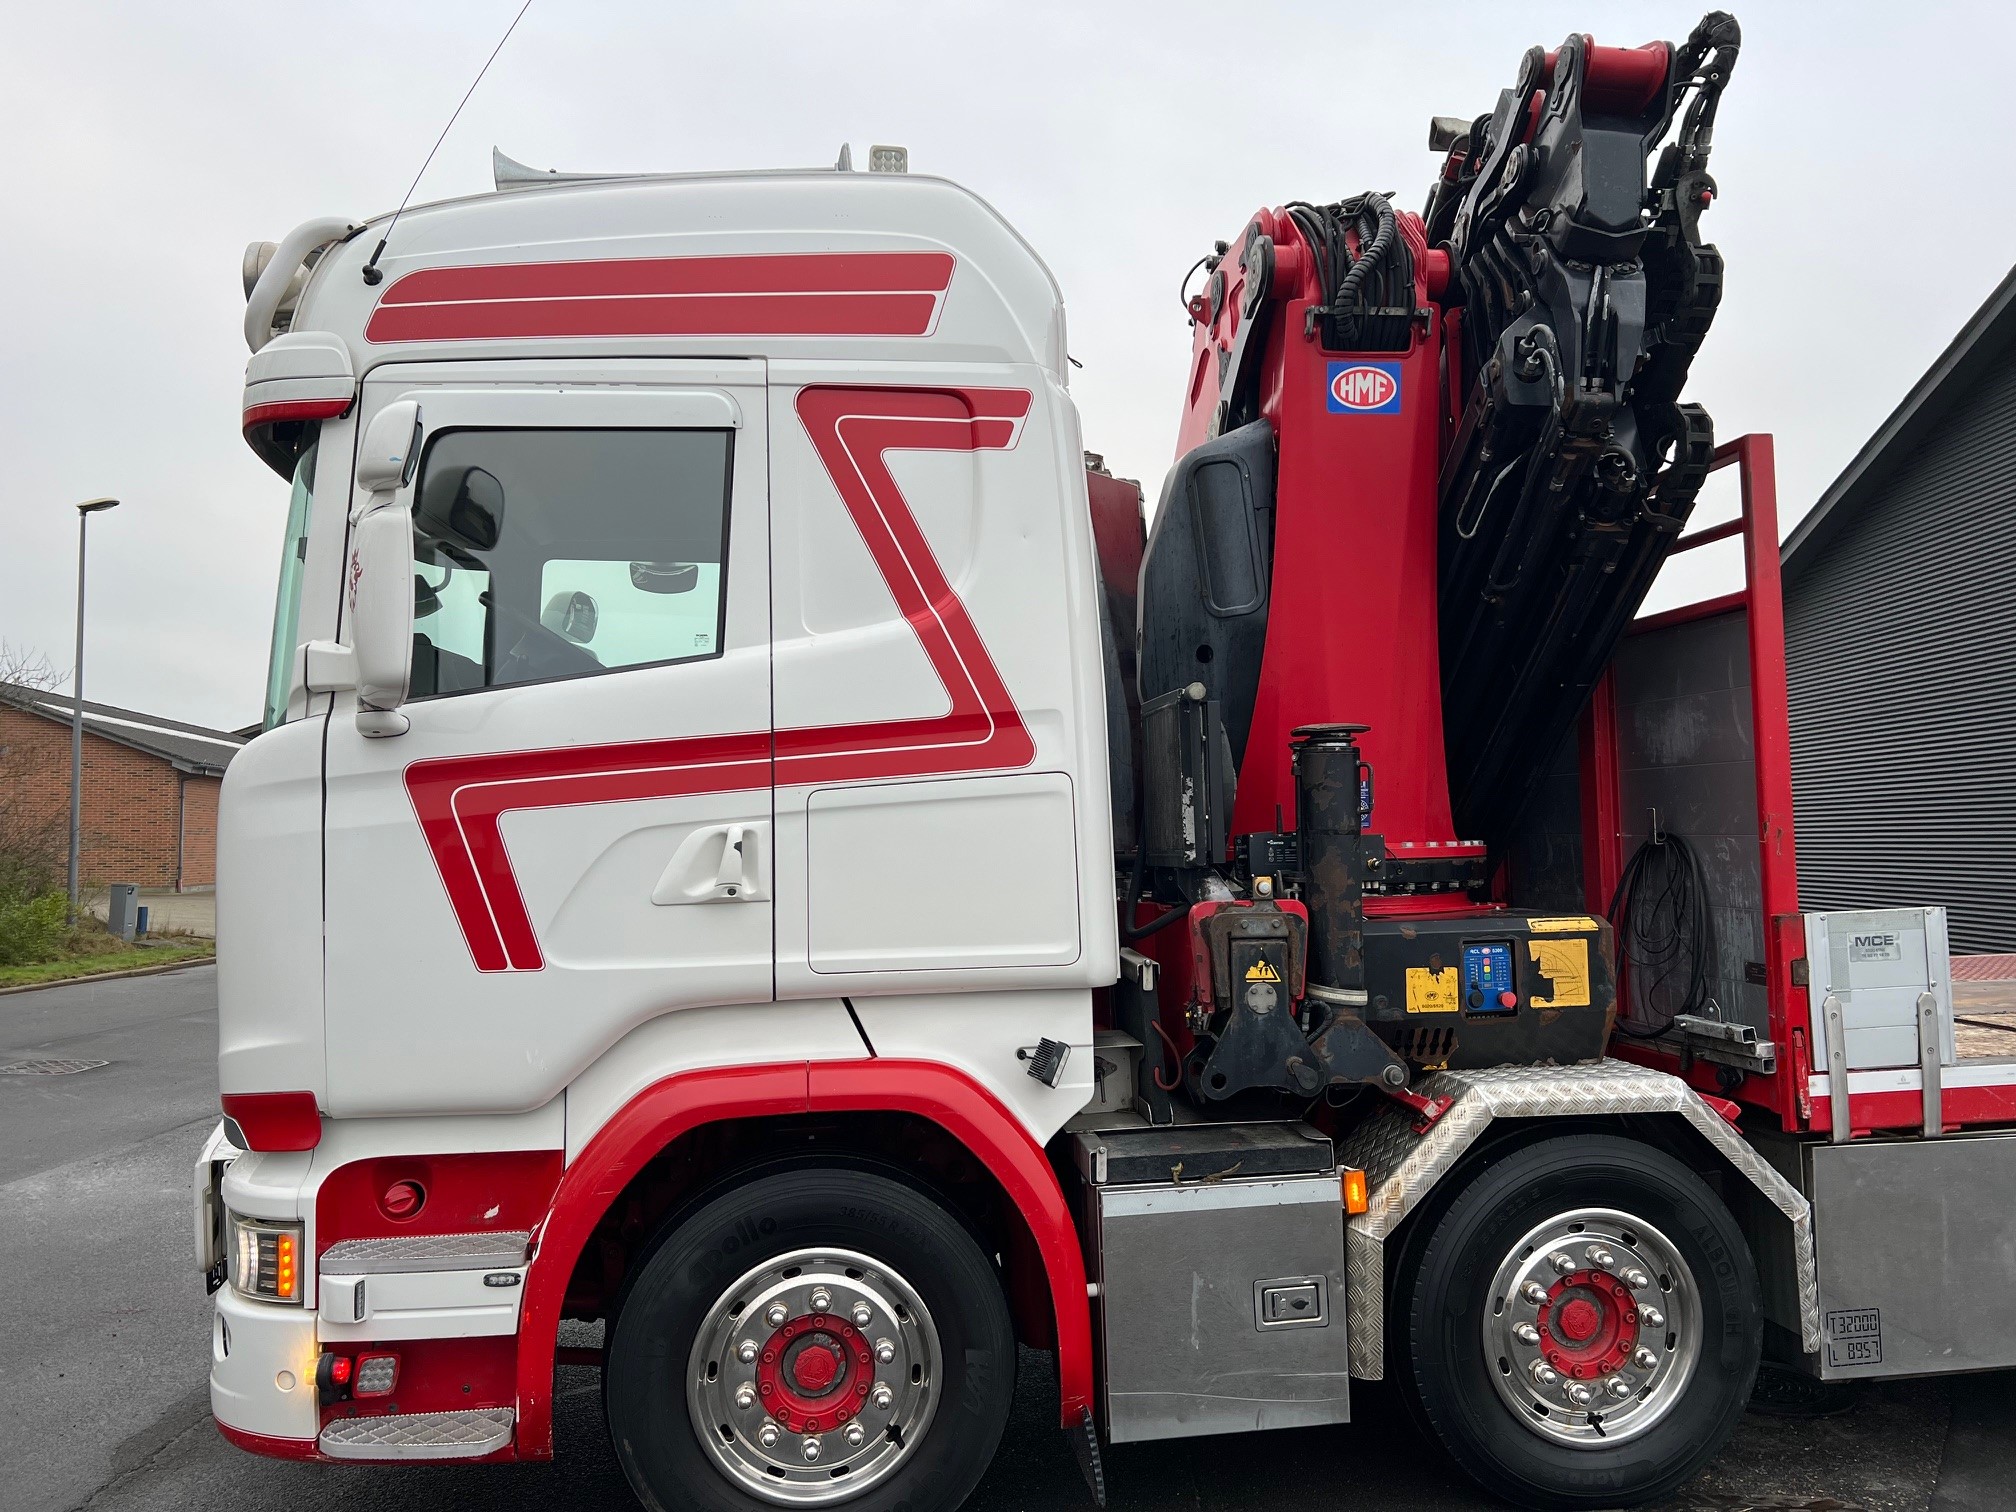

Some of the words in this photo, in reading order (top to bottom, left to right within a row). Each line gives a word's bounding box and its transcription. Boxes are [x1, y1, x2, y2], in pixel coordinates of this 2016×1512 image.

[1340, 372, 1388, 404] HMF
[1855, 935, 1894, 947] MCE
[1838, 1314, 1878, 1334] 32000
[1832, 1350, 1839, 1361] L
[1847, 1341, 1879, 1360] 8957
